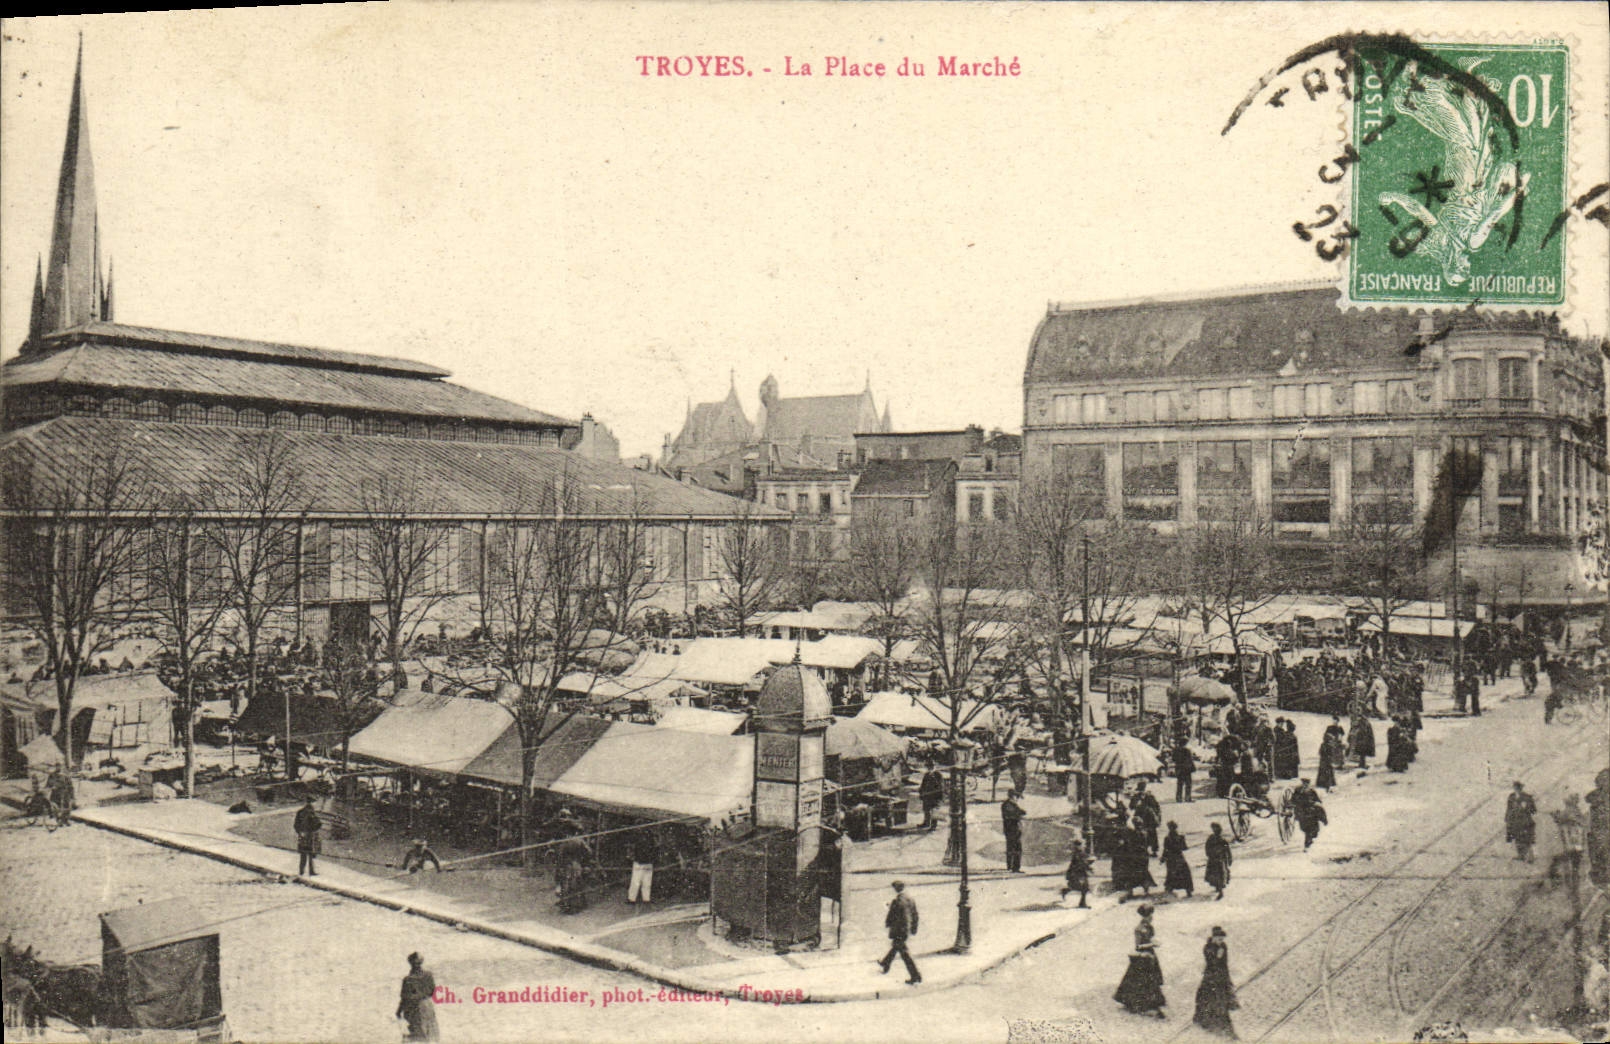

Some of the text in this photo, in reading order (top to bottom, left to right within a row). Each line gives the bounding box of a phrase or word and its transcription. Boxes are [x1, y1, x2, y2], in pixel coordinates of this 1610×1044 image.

[1508, 73, 1559, 129] 10
[1360, 272, 1556, 294] REPUBLIQUE FRANÇAISE
